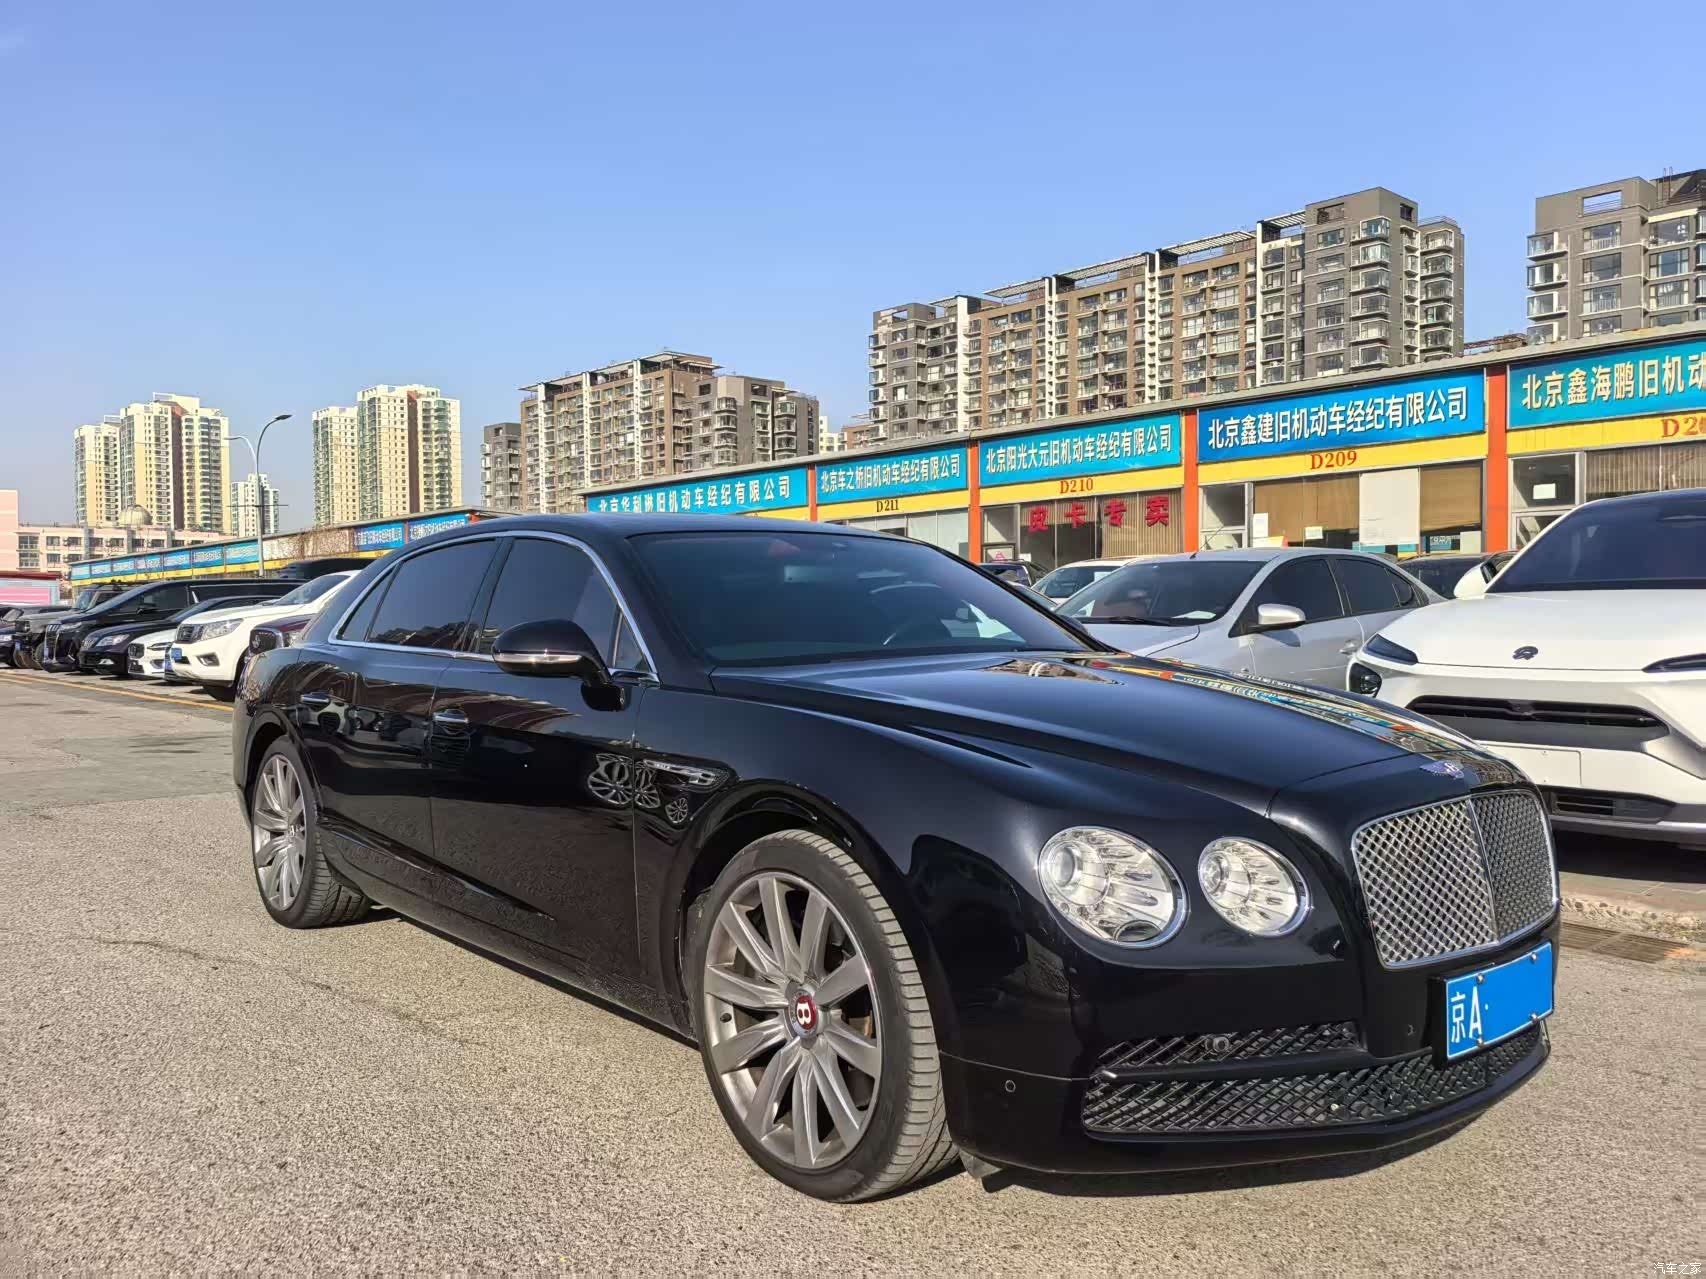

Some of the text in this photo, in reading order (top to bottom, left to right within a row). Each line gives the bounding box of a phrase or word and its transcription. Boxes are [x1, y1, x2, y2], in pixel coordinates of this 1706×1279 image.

[1208, 386, 1467, 449] 北京鑫建旧机动车经纪有限公司
[986, 424, 1172, 473] 北京阳光大元旧机动车经纪有限公司
[1310, 450, 1357, 470] D209
[1060, 478, 1094, 494] D210
[876, 499, 899, 513] D211
[1028, 496, 1169, 533] 皮卡专卖
